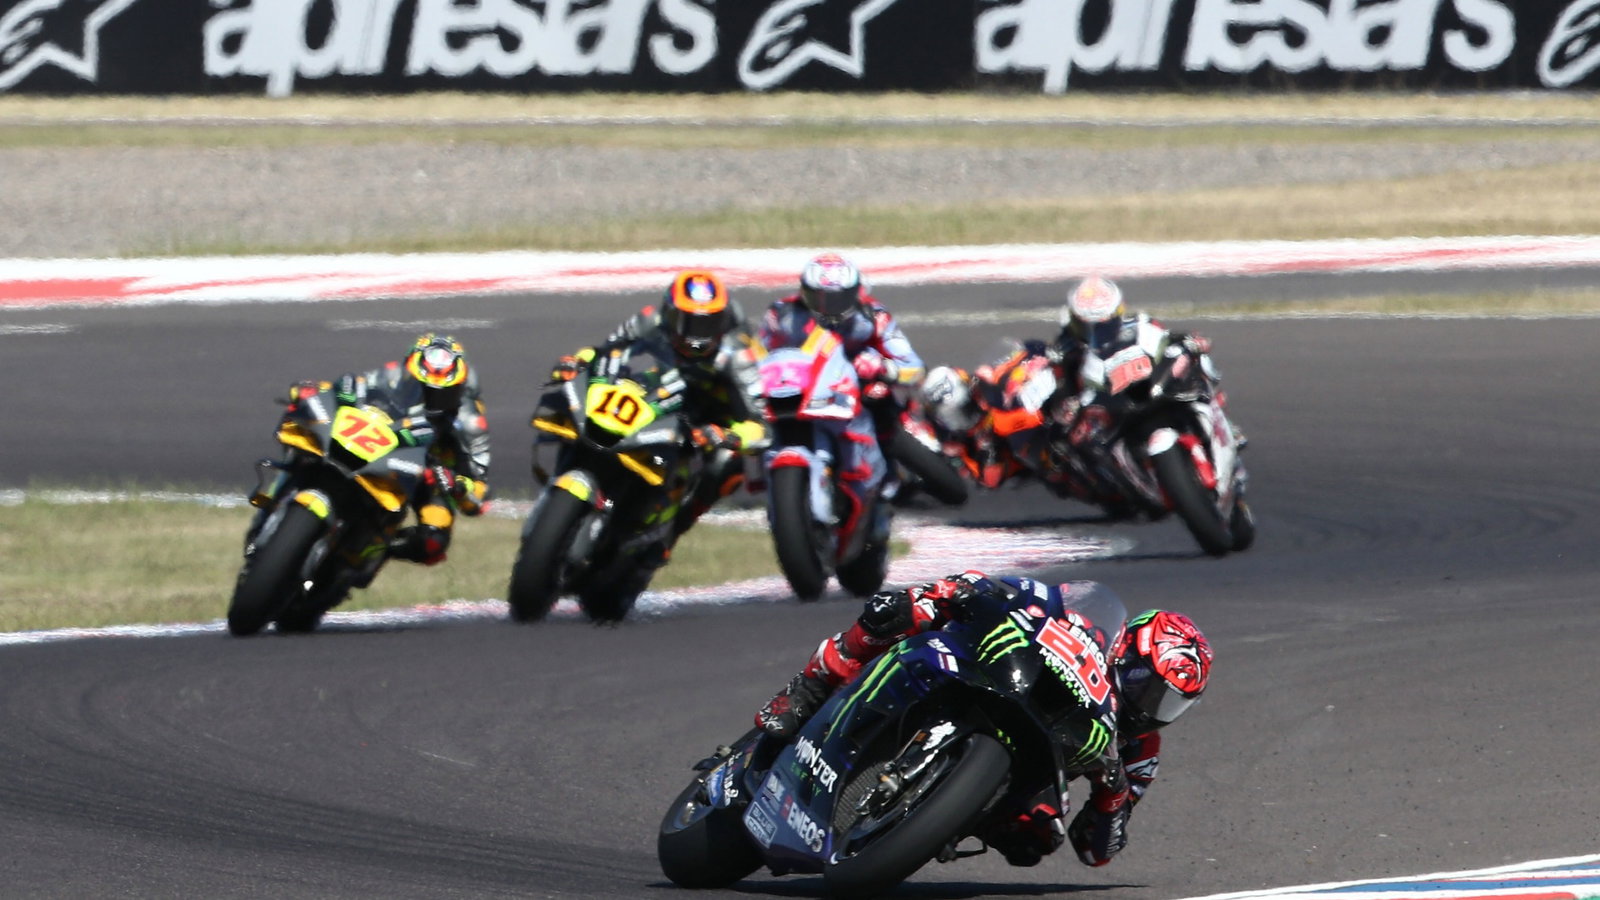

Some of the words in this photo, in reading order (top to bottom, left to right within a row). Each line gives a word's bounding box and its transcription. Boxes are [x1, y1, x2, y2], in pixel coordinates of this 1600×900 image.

[339, 414, 392, 454] 72
[593, 390, 640, 427] 10
[1036, 616, 1111, 705] 20
[1069, 625, 1107, 676] ENEOS
[786, 801, 826, 853] ENEOS
